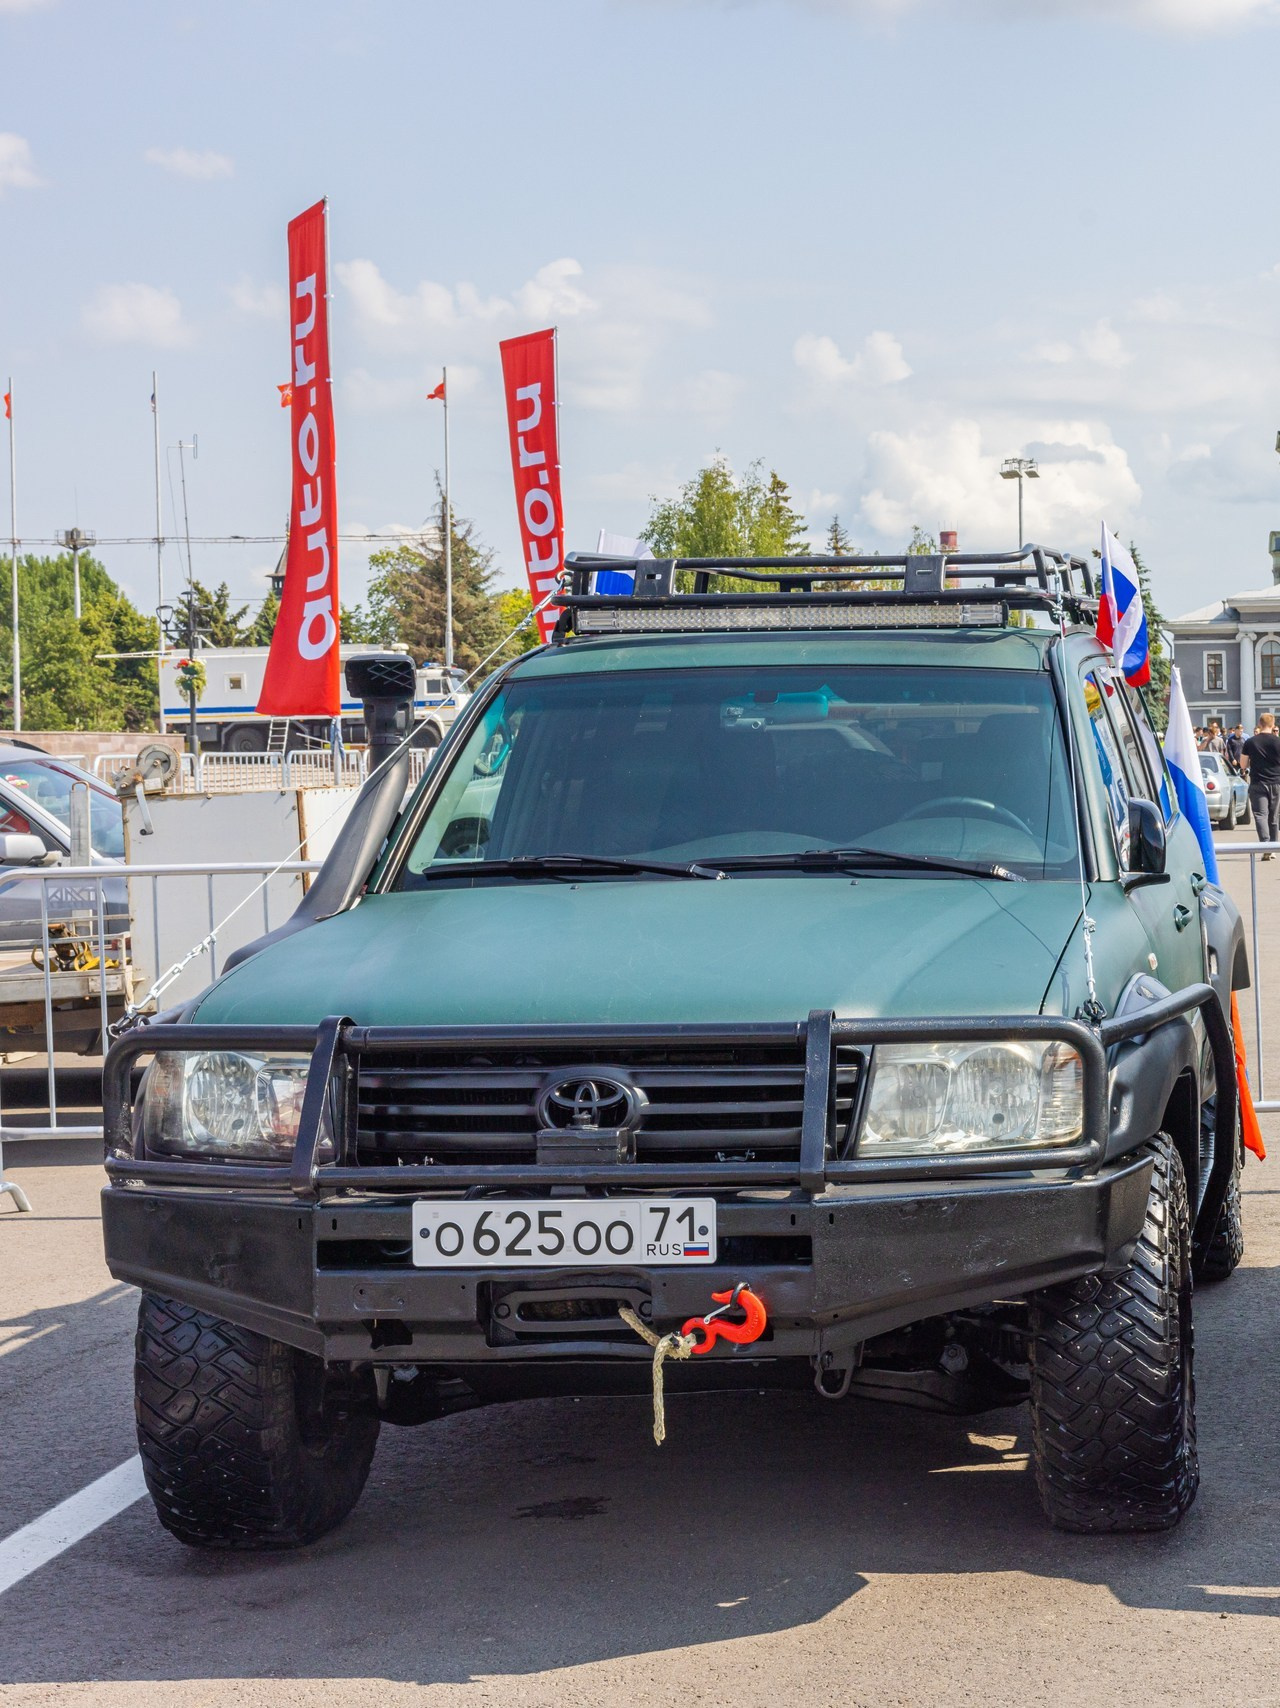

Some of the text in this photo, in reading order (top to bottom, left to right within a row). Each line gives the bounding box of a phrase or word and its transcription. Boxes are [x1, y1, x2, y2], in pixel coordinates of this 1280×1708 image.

[294, 272, 336, 661] auto.ru
[516, 382, 560, 644] uto.ru
[646, 1243, 682, 1256] RUS
[649, 1206, 696, 1242] 71
